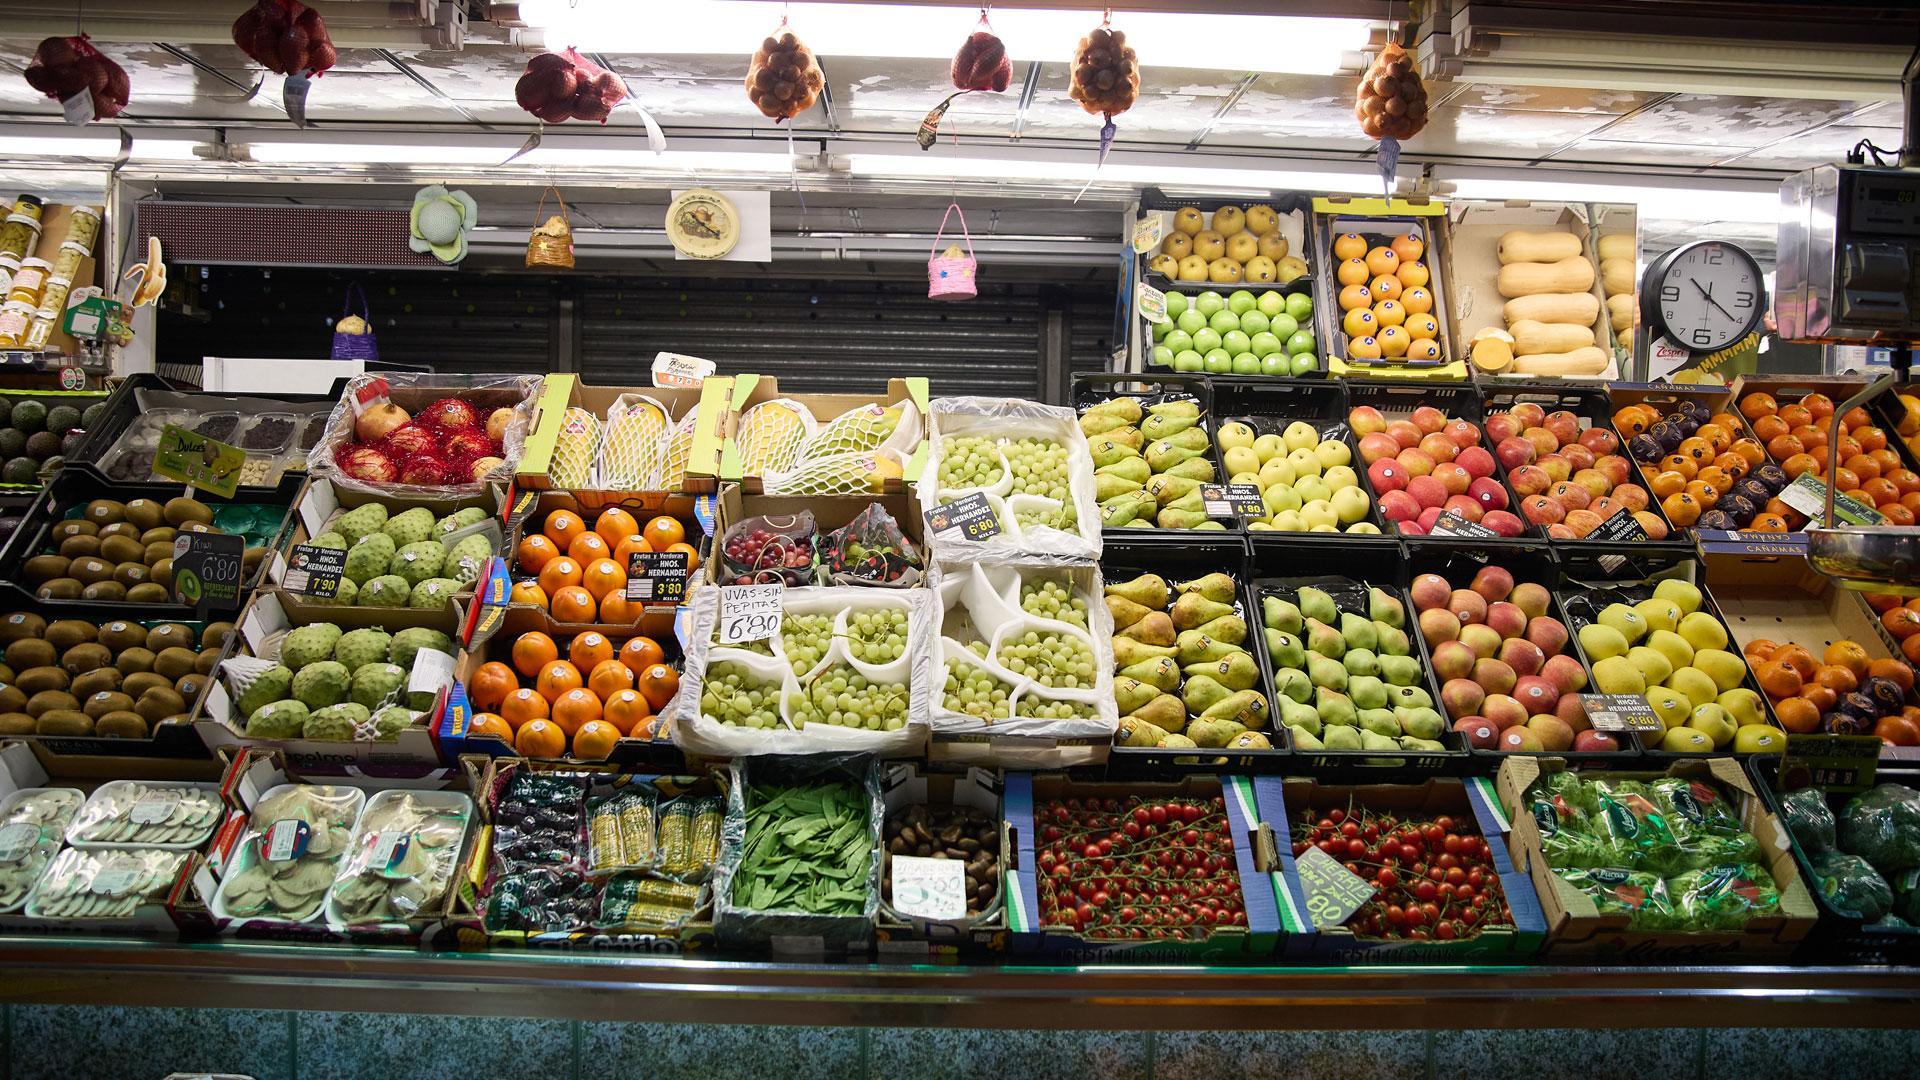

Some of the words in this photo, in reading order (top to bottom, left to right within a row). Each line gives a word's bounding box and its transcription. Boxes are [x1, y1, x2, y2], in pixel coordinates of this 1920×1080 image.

[1689, 255, 1696, 263] 11
[1703, 249, 1724, 265] 12
[1672, 269, 1682, 278] 10
[1741, 275, 1749, 283] 2
[1661, 286, 1680, 302] 9
[1734, 291, 1753, 308] 3
[1666, 311, 1673, 319] 8
[1736, 316, 1743, 324] 4
[1693, 329, 1711, 345] 6
[1656, 346, 1684, 357] Zespri
[929, 506, 948, 516] Frutas
[954, 494, 980, 507] Verduras
[958, 502, 980, 513] HNOS.
[951, 506, 991, 524] HERNANDEZ
[1605, 511, 1625, 526] Verduras
[969, 519, 994, 535] 6'80
[1471, 522, 1496, 535] Verduras
[1609, 518, 1628, 533] HNOS.
[321, 548, 344, 556] Verduras
[319, 555, 338, 564] HNOS.
[660, 560, 680, 568] HNOS.
[202, 556, 238, 580] 6'80
[306, 563, 343, 574] HERNANDEZ
[648, 568, 687, 577] HERNANDEZ
[313, 578, 335, 590] 7'90
[657, 583, 682, 595] 3'80
[724, 599, 779, 613] PEPITAS
[728, 615, 778, 640] 6'80
[1626, 716, 1655, 726] 3'80
[1308, 851, 1374, 898] CHERRIS
